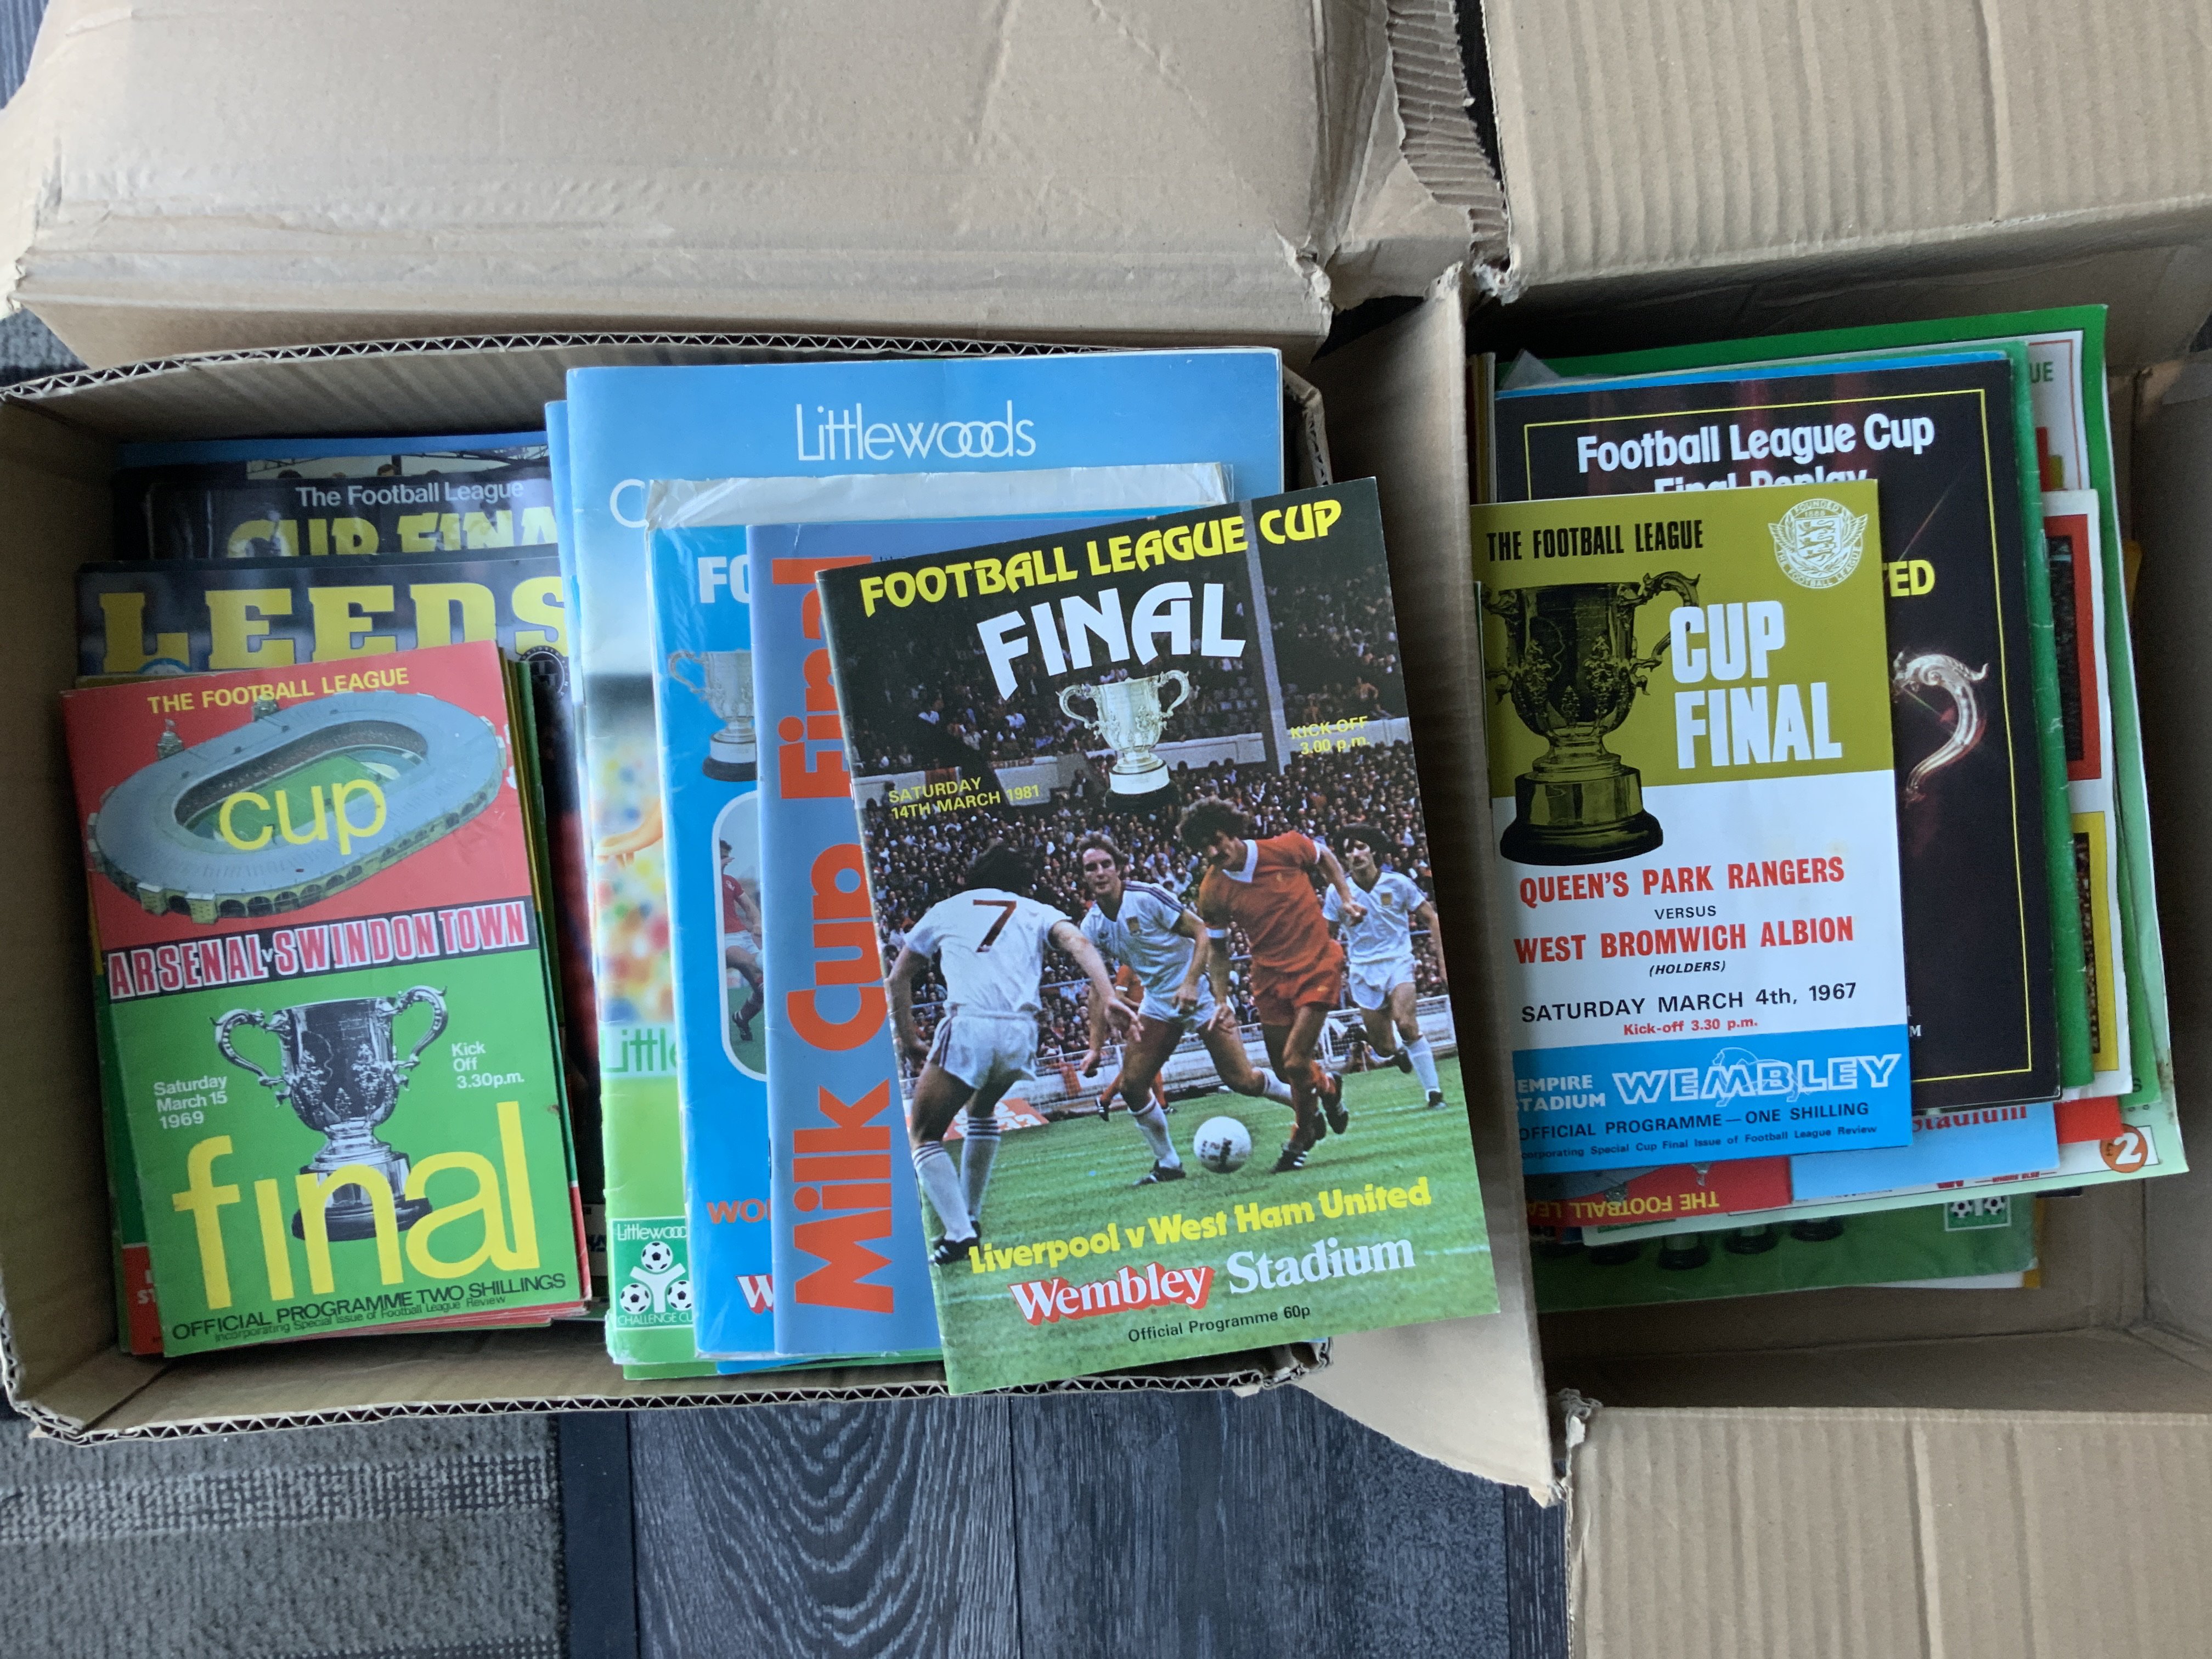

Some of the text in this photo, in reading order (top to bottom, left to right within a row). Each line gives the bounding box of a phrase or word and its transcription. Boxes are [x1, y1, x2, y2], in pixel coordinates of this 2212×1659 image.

[796, 399, 1036, 461] Littlewoods
[1577, 413, 1935, 473] Football League Cup
[296, 482, 523, 507] The Football League
[860, 499, 1342, 618] FOOTBALL LEAGUE CUP
[1486, 520, 1704, 562] THE FOOTBALL LEAGUE
[99, 576, 569, 673] LEEDS
[977, 581, 1246, 701] FINAL
[1669, 600, 1786, 684] CUP
[147, 668, 409, 713] THE FOOTBALL LEAGUE
[1290, 715, 1368, 739] KICK OFF
[1300, 736, 1370, 755] 3.00 p.m.
[1674, 682, 1842, 769] FINAL
[889, 777, 981, 803] SATURDAY
[891, 785, 1039, 820] 14TH MARCH 1981
[218, 778, 387, 855] cup
[1520, 856, 1844, 909] QUEEN'S PARK RANGERS
[973, 899, 1017, 953] 7
[1654, 905, 1717, 920] VERSUS
[108, 934, 269, 1000] ARSENAL
[273, 911, 439, 975] SWINDON
[438, 900, 529, 955] TOWN
[787, 843, 887, 1051] Cup
[1514, 916, 1853, 964] WEST BROMWICH ALBION
[1649, 961, 1726, 977] (HOLDERS)
[1521, 982, 1857, 1023] SATURDAY MARCH 4th, 1967
[1623, 1018, 1758, 1036] Kick-off 3.30 p.m.
[452, 1041, 486, 1057] Kick
[453, 1057, 477, 1072] Off
[600, 1028, 676, 1073] Littl
[154, 1075, 227, 1096] Saturday
[457, 1073, 525, 1089] 3.30p.m.
[1517, 1053, 1901, 1104] EMPIRE WEMBLEY
[157, 1091, 228, 1112] March 15
[160, 1110, 204, 1129] 1969
[1517, 1093, 1606, 1112] TADIUM
[1519, 1124, 1596, 1141] OFFICIAL
[1605, 1114, 1722, 1134] PROGRAMME
[1745, 1109, 1781, 1124] ONE
[1790, 1102, 1869, 1121] SHILLING
[1591, 1144, 1629, 1155] Special
[1635, 1142, 1657, 1153] Cup
[1662, 1139, 1688, 1149] Final
[1694, 1138, 1721, 1147] Issue
[1727, 1135, 1739, 1144] of
[1745, 1131, 1788, 1143] Football
[1795, 1128, 1831, 1139] League
[1838, 1125, 1877, 1135] Review
[172, 1101, 540, 1310] final
[793, 1077, 894, 1313] Milk
[1570, 1195, 1672, 1218] FOOTBALL
[1679, 1190, 1720, 1211] THE
[969, 1176, 1431, 1274] Liverpool v West Ham United
[1008, 1237, 1416, 1322] Wembley Stadium
[172, 1273, 566, 1340] OFFICIAL PROGRAMME TWO SHILLINGS
[215, 1296, 506, 1344] Incorporating Special Issue of Football League Review
[618, 1312, 676, 1325] CHALLENGE
[1128, 1305, 1311, 1342] Official Programme 60p
